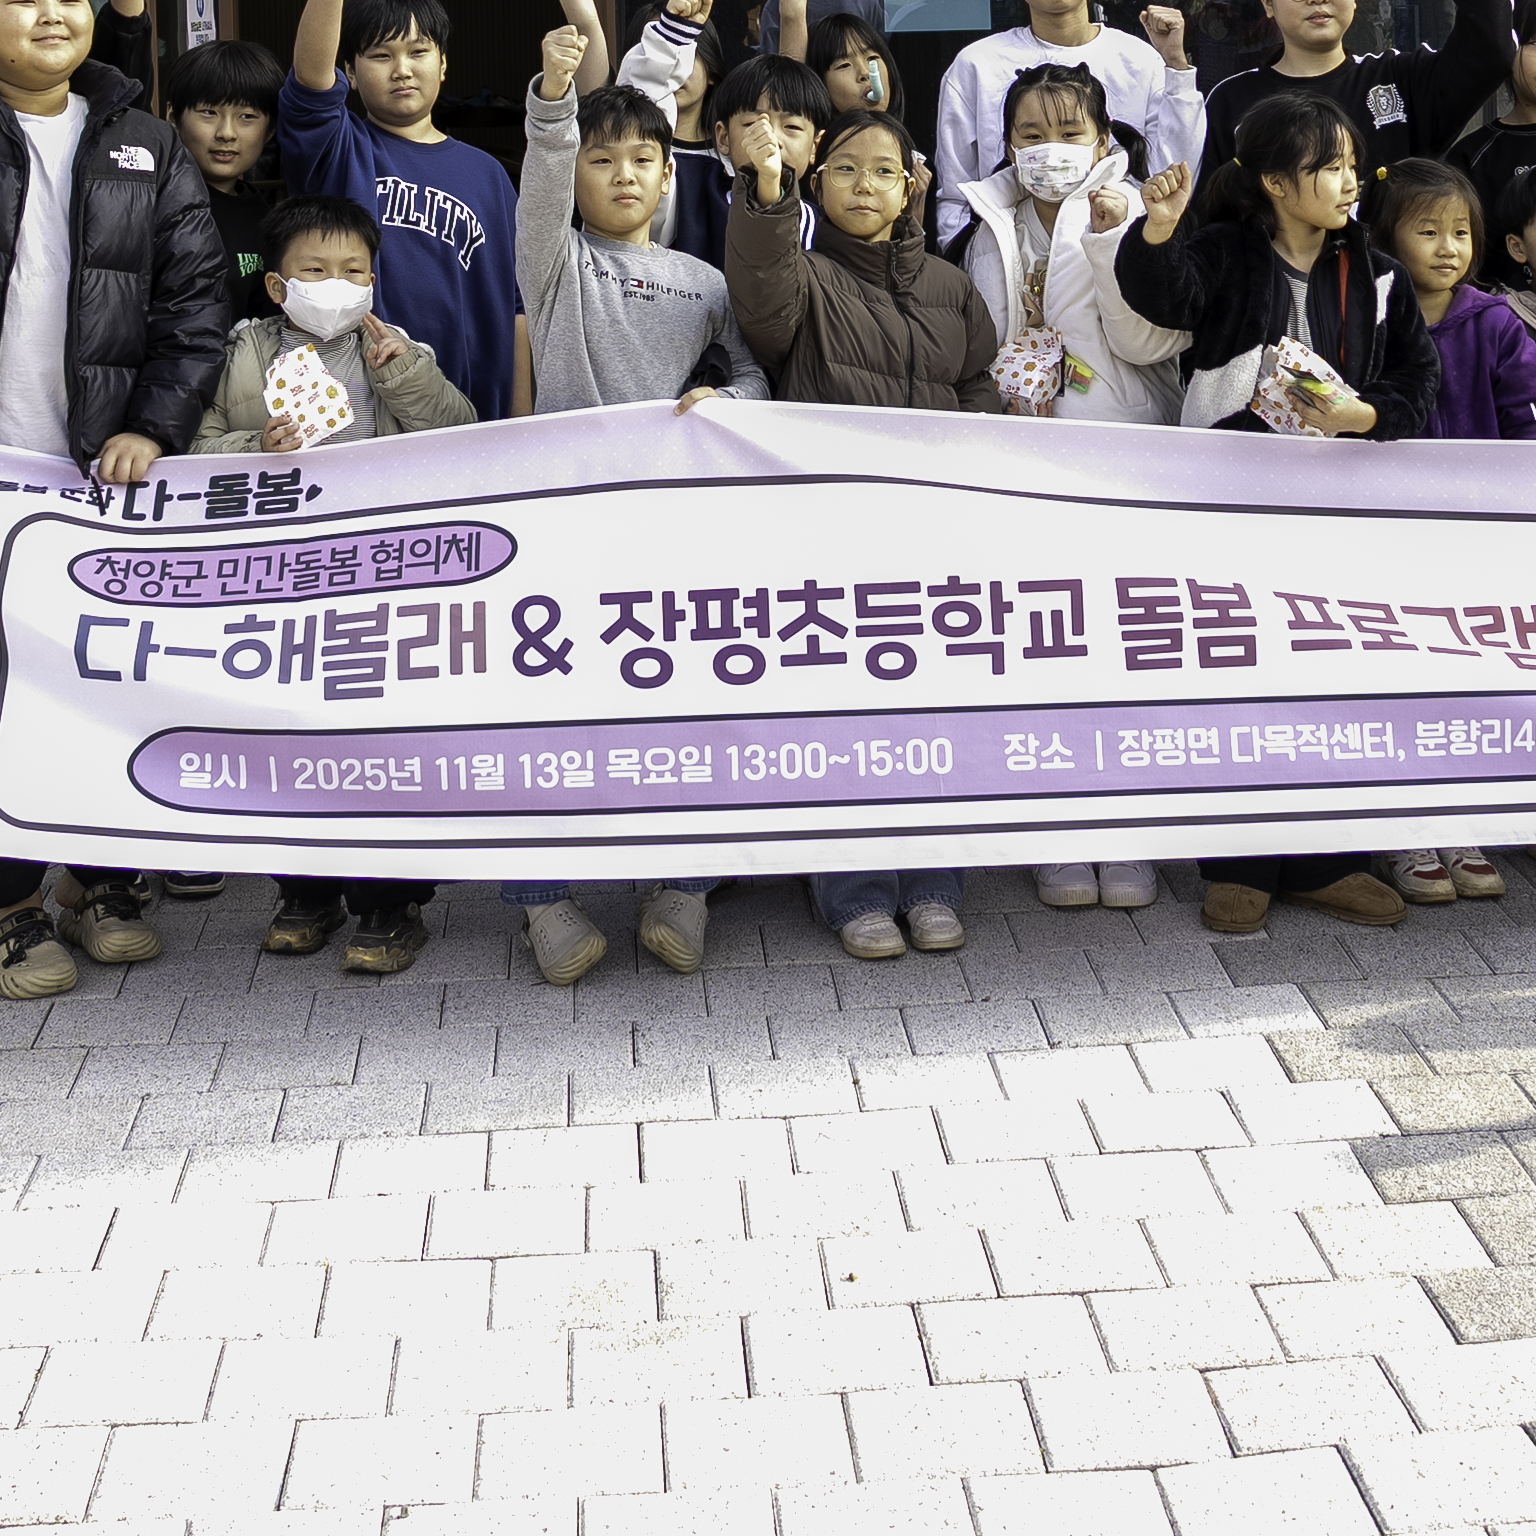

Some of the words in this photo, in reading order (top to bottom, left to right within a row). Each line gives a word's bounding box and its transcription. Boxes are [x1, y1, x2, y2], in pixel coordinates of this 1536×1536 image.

[646, 282, 703, 301] HILFIGER
[121, 467, 304, 522] 다-돌봄
[94, 555, 209, 598] 청양군
[217, 545, 363, 596] 민간돌봄
[370, 531, 482, 582] 협의체
[74, 600, 487, 701] 다-해볼래
[511, 595, 574, 677] &
[599, 575, 1089, 689] 장평초등학교
[1115, 576, 1258, 672] 돌봄
[178, 751, 248, 791] 일시
[293, 755, 424, 792] 2025년
[434, 753, 506, 791] 11월
[519, 750, 595, 789] 13일
[605, 745, 713, 787] 목요일
[725, 737, 953, 781] 13:00~15:00
[1004, 732, 1076, 772] 장소
[1118, 726, 1221, 767] 장평면
[1230, 722, 1406, 763] 다목적센터,
